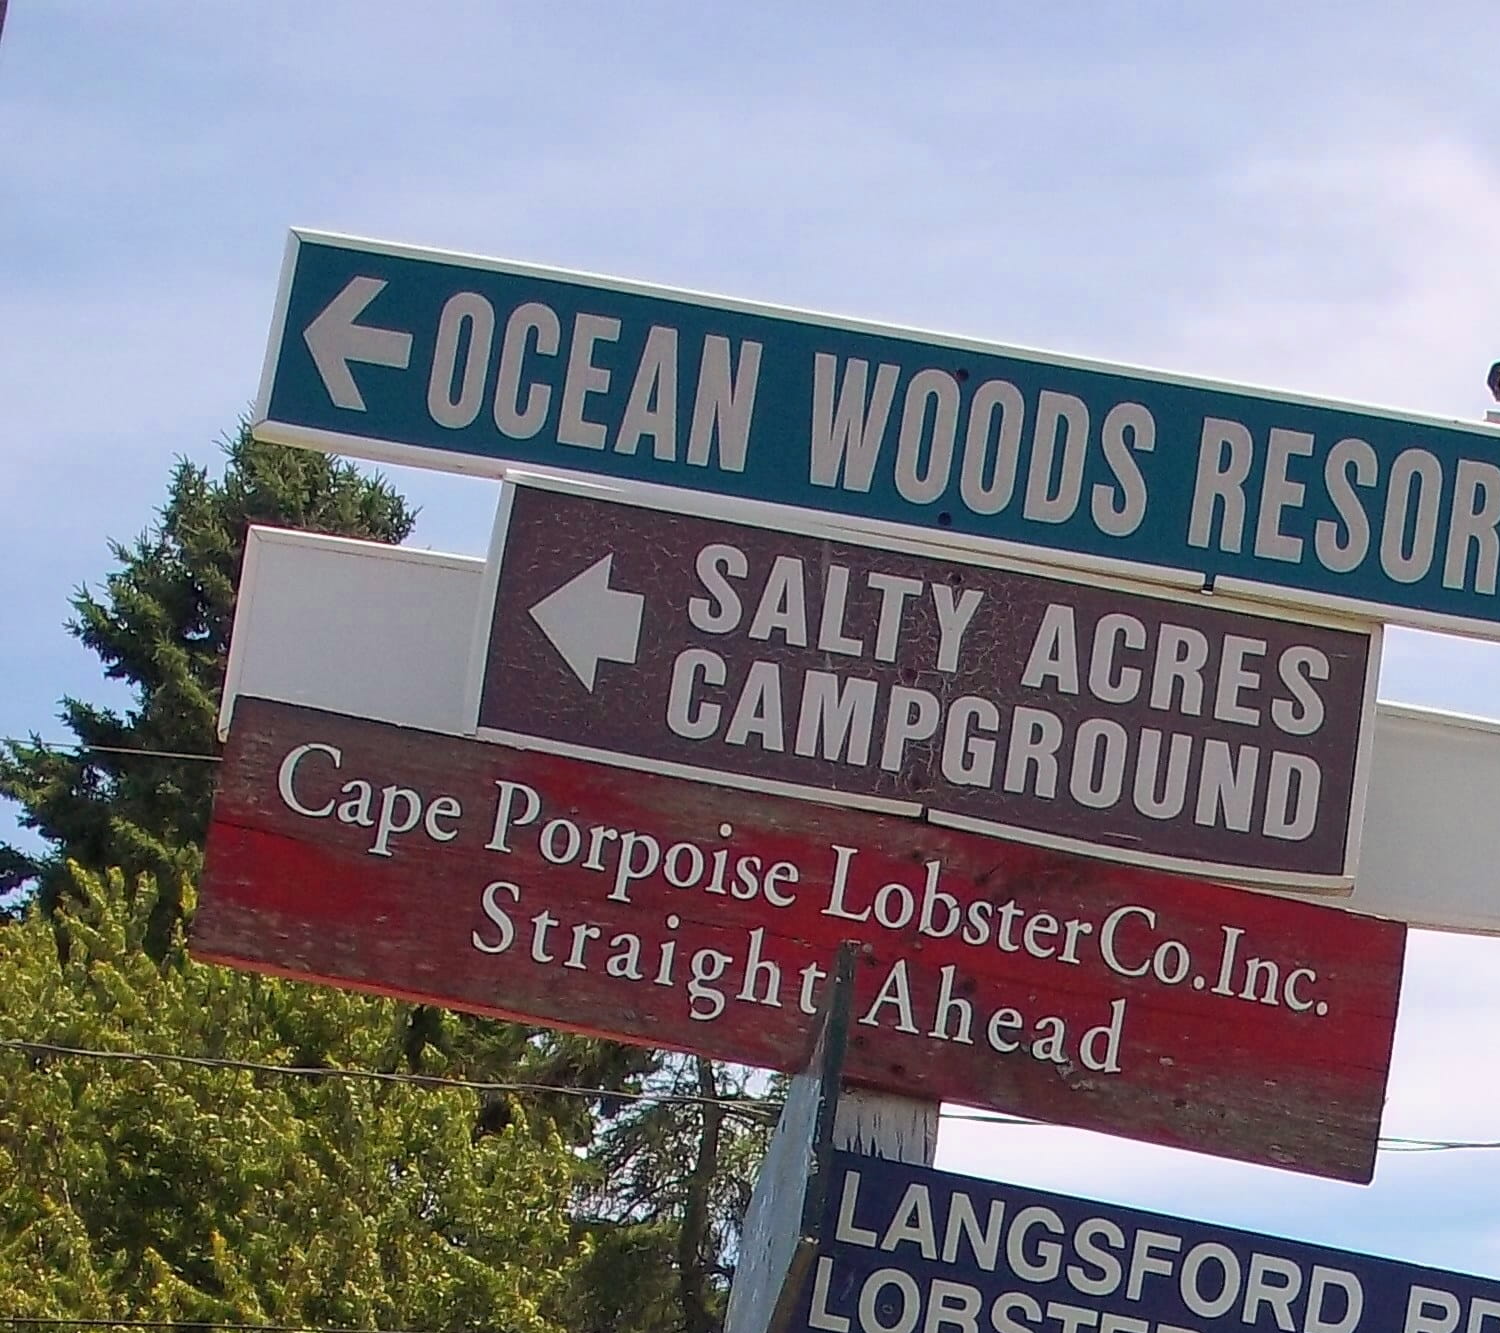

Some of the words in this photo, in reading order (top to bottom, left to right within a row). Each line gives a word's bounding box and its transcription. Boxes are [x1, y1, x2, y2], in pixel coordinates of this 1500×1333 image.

[427, 291, 763, 474] OCEAN
[809, 351, 1156, 536] WOODS
[688, 543, 985, 673] SALTY
[1021, 603, 1330, 736] ACRES
[277, 743, 462, 857] Cape
[484, 780, 800, 908] Porpoise
[667, 648, 1322, 842] CAMPGROUND
[472, 880, 828, 1021] Straight
[858, 958, 1127, 1075] Ahead
